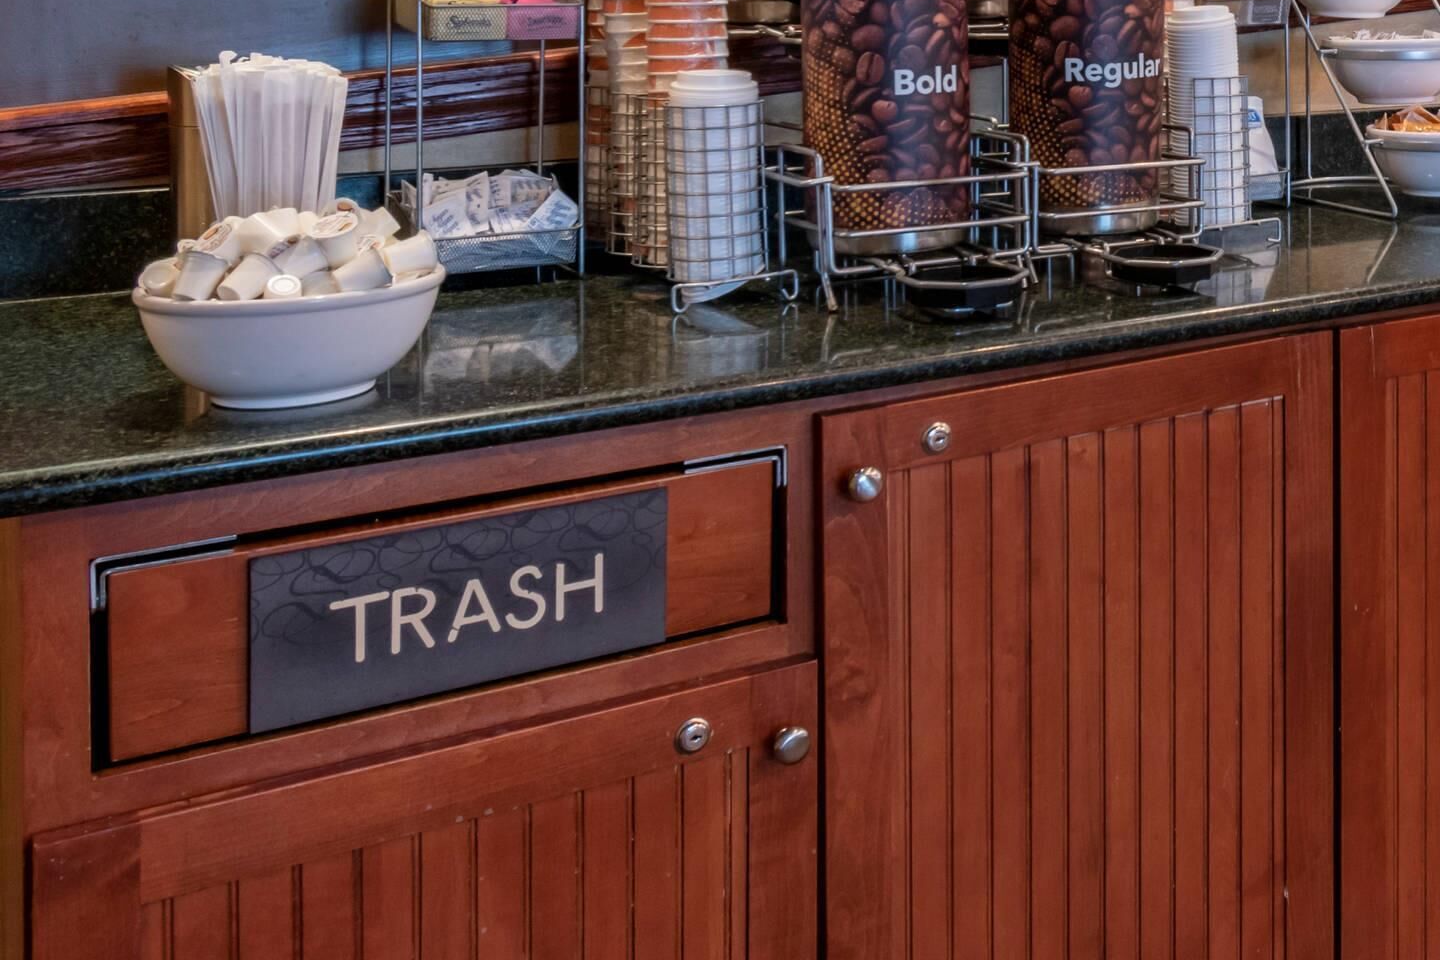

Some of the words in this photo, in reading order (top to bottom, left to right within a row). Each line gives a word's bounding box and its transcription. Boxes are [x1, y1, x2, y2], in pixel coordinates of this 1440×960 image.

[894, 65, 957, 96] Bold
[1064, 53, 1161, 88] Regular
[329, 553, 604, 663] TRASH
